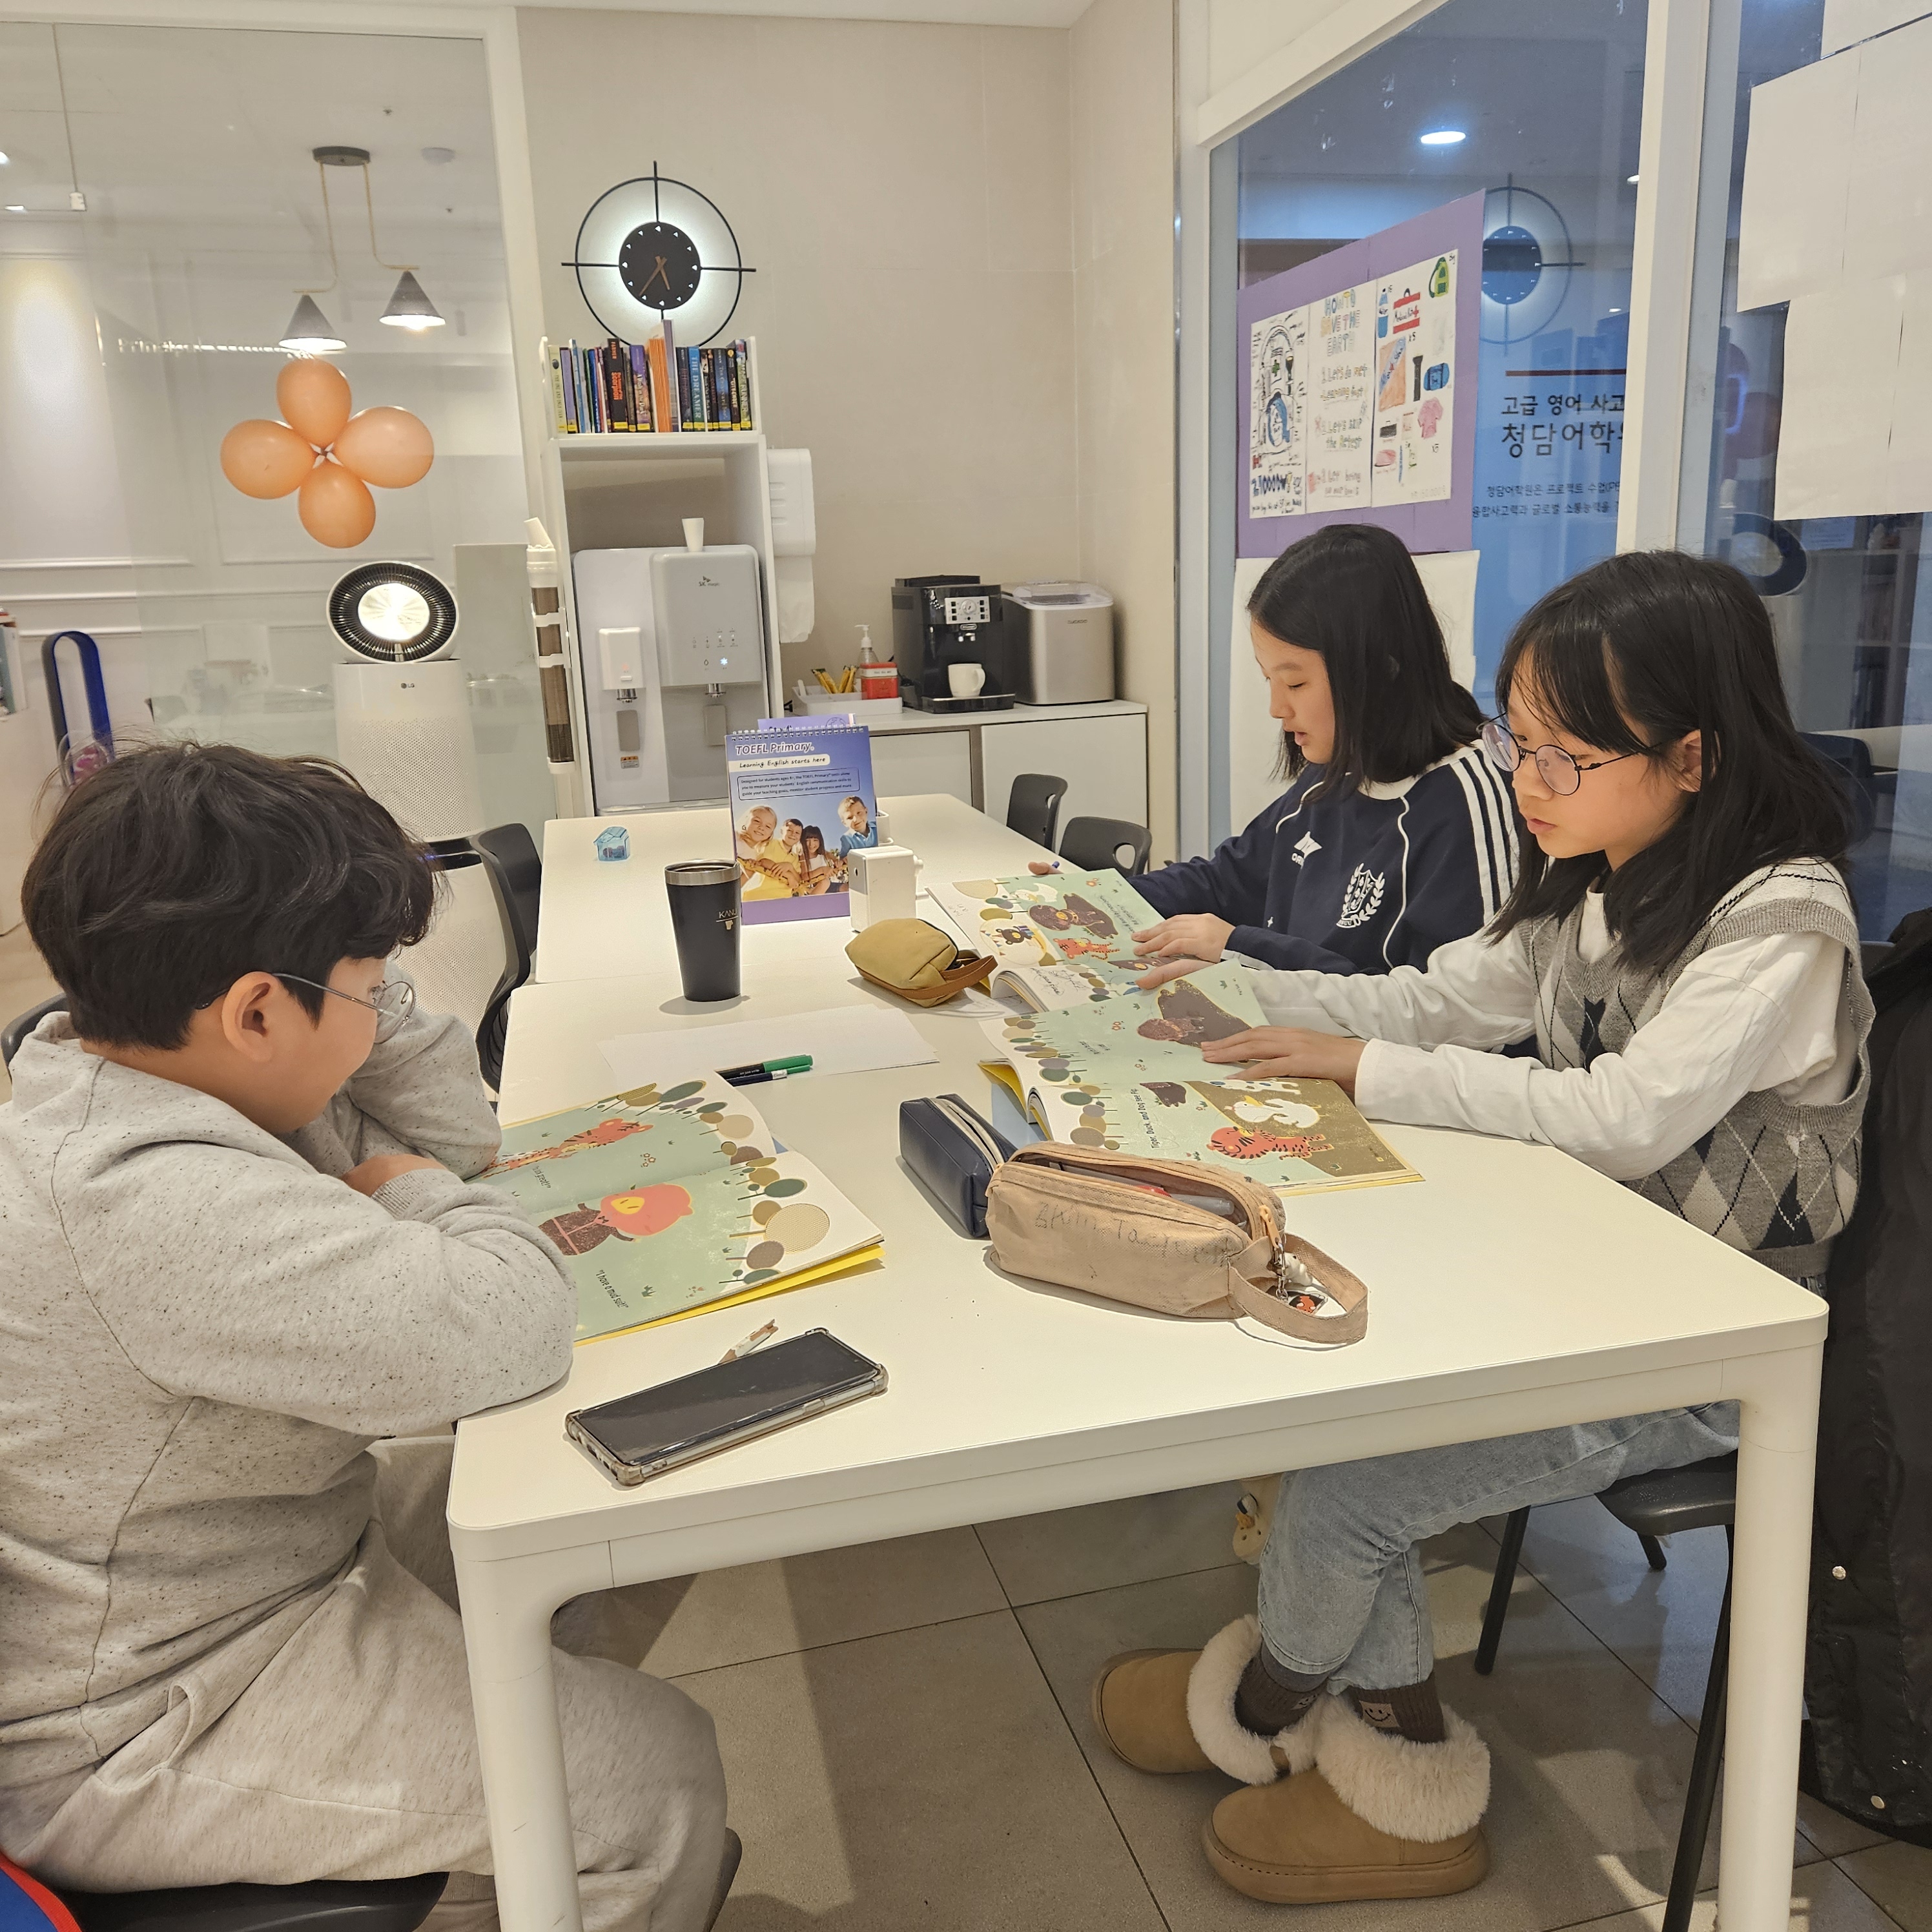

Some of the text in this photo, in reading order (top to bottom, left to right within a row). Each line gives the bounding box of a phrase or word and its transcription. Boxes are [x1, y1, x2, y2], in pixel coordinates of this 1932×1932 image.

[693, 375, 701, 418] DREAMER
[1501, 395, 1538, 416] 고급
[1548, 393, 1581, 416] 영어
[735, 744, 769, 756] TOEFL
[767, 759, 789, 767] English
[719, 907, 737, 919] KANU
[1137, 1102, 1146, 1111] Dog
[1138, 1111, 1149, 1120] and
[597, 1274, 610, 1286] have
